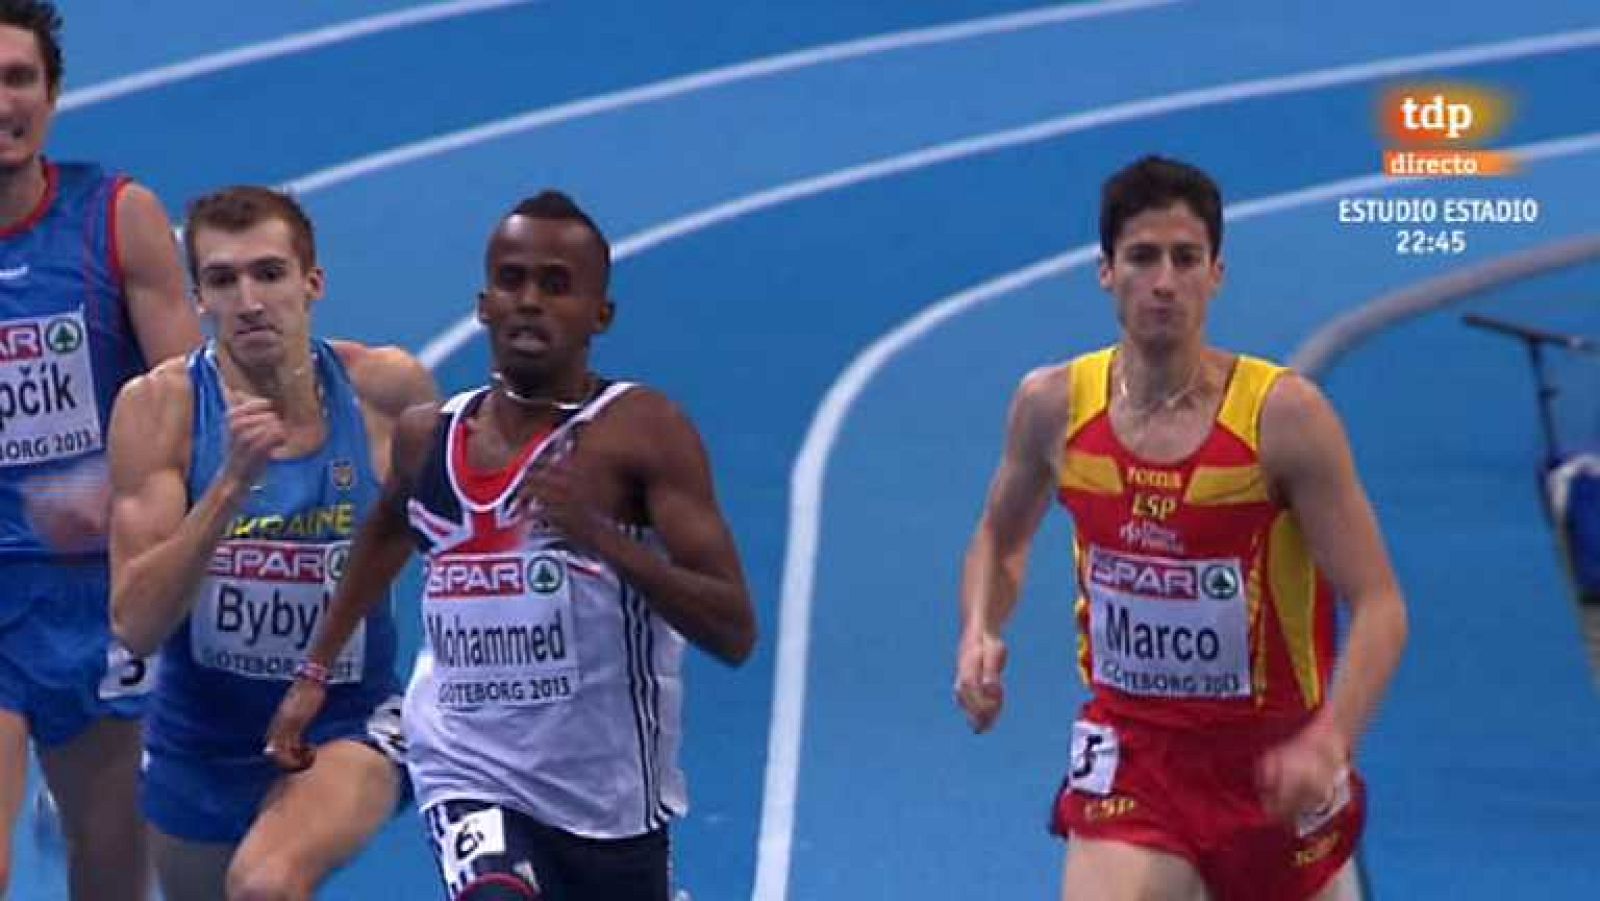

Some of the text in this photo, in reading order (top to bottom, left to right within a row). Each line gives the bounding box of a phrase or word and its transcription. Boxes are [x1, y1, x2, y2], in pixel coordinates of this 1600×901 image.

[209, 546, 324, 578] SPAR
[429, 562, 522, 594] SPAR
[1092, 555, 1194, 597] SPAR
[217, 584, 330, 649] Byby
[1105, 602, 1220, 661] Marco
[427, 610, 566, 668] Mohammed
[1072, 735, 1103, 778] 5
